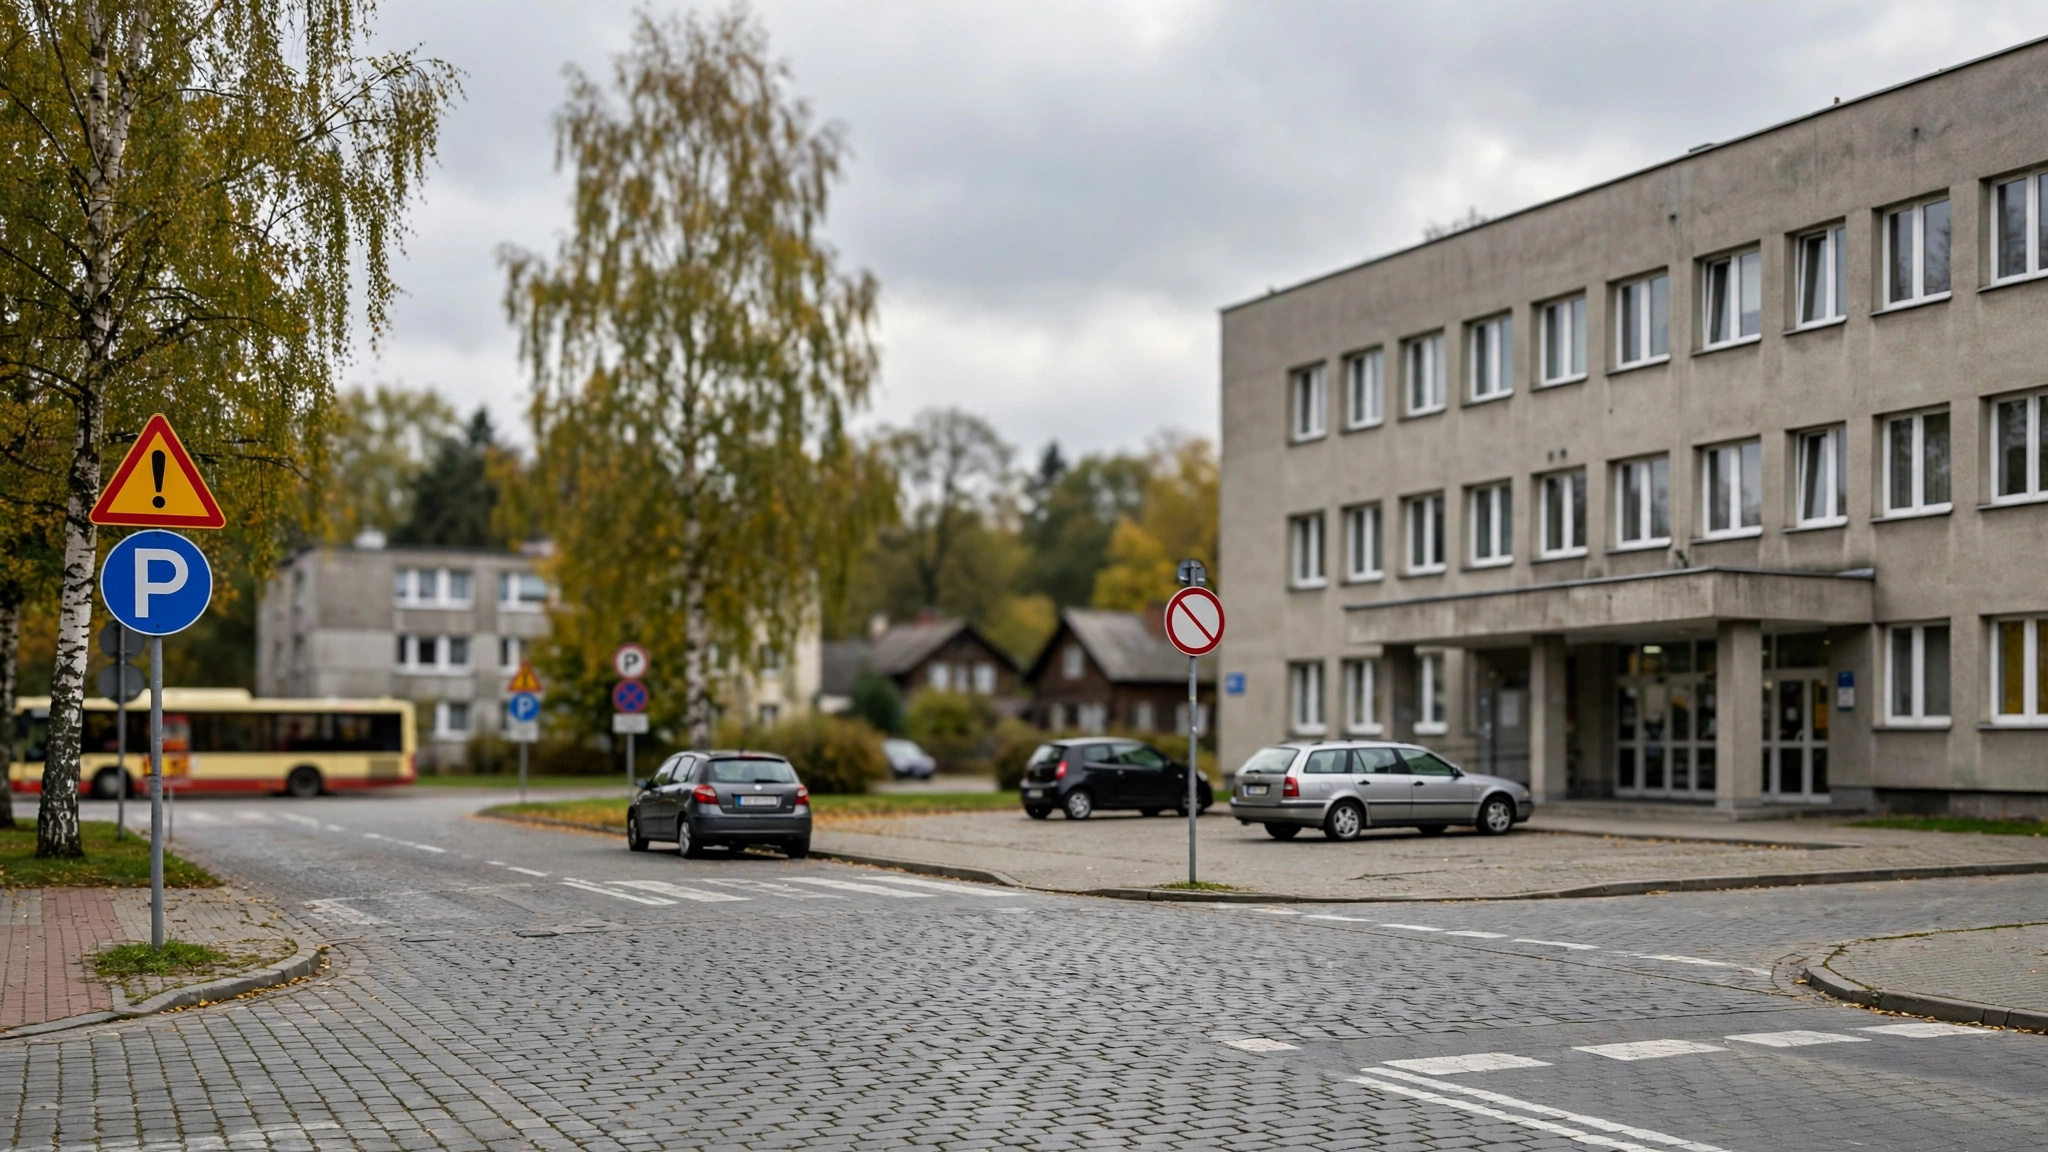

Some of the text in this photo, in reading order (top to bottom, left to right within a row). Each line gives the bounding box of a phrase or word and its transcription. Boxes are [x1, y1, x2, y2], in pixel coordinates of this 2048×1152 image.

[135, 548, 188, 618] P
[624, 652, 639, 672] P
[518, 696, 534, 718] P
